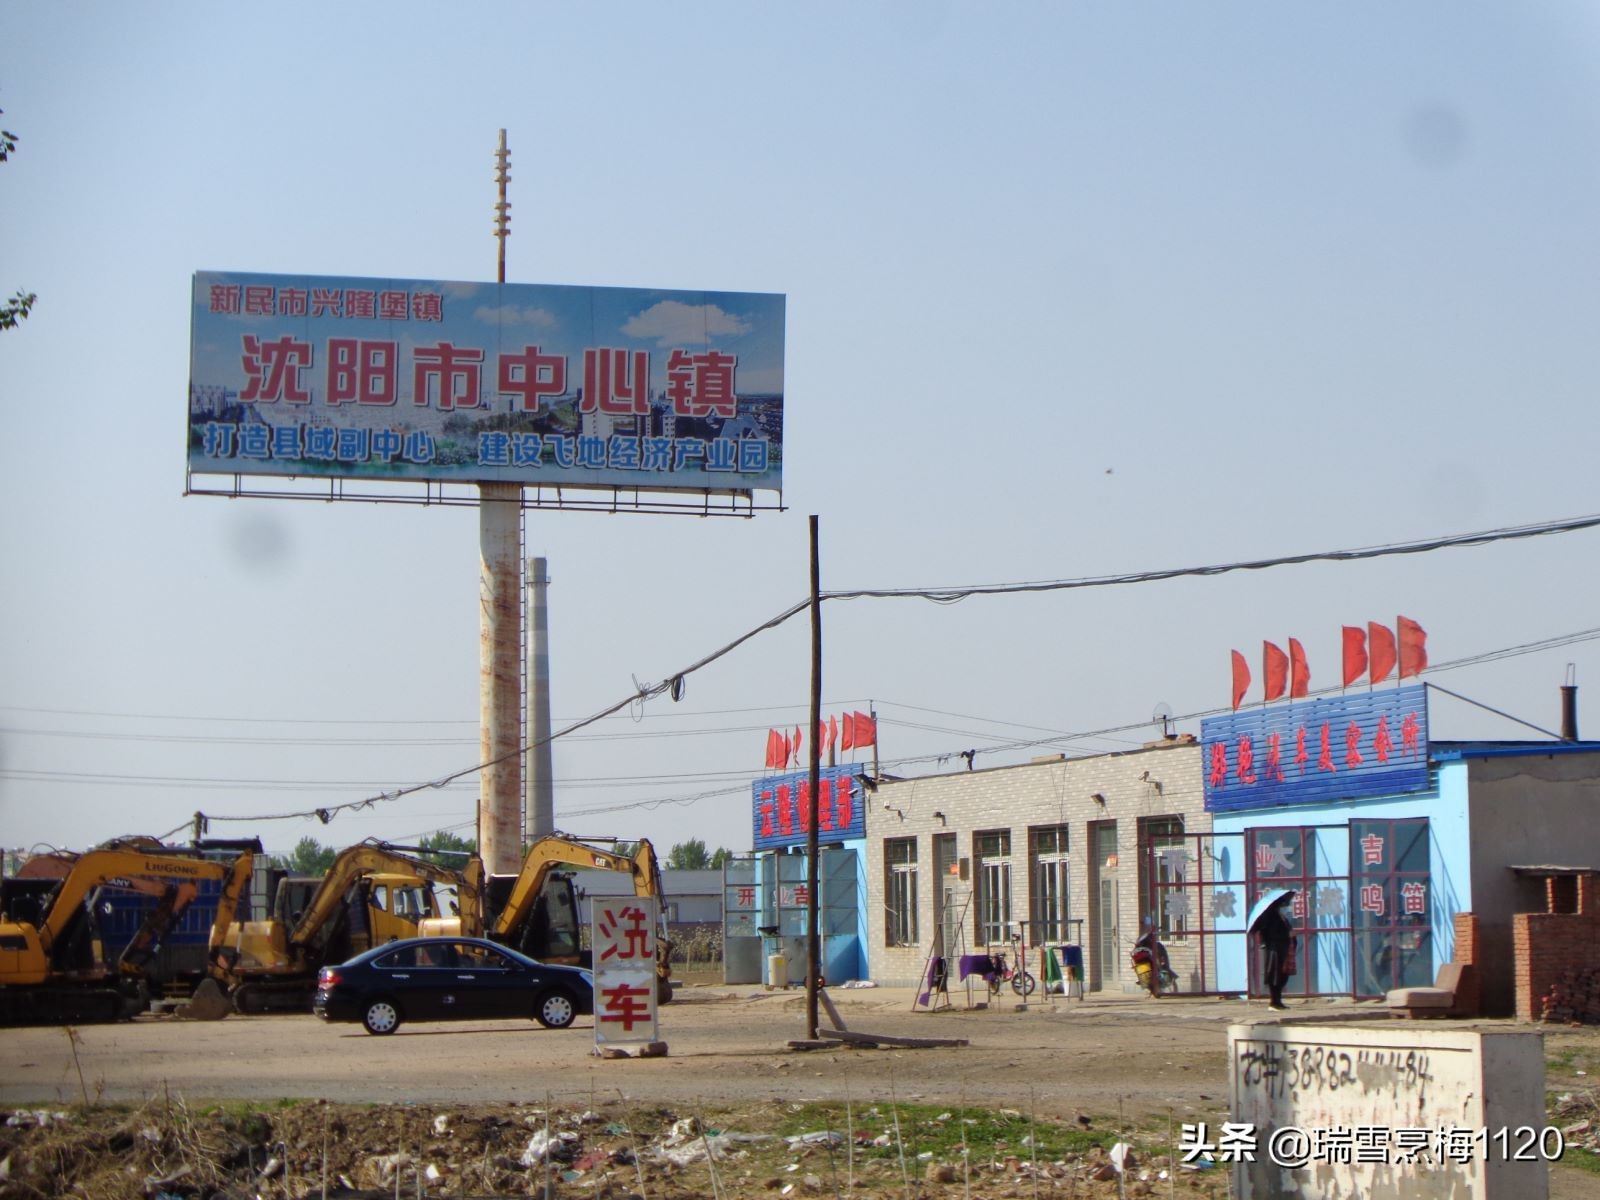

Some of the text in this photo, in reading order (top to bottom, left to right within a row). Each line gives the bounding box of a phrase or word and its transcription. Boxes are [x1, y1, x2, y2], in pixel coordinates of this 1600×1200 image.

[209, 284, 443, 321] 新民市兴隆堡镇
[239, 334, 738, 417] 沈阳市中心镇
[203, 422, 769, 473] 打造县域副中心 建设飞地经济产业园
[596, 857, 607, 867] CAT
[1361, 834, 1384, 865] 吉
[738, 887, 755, 906] 开
[599, 906, 652, 1031] 洗车
